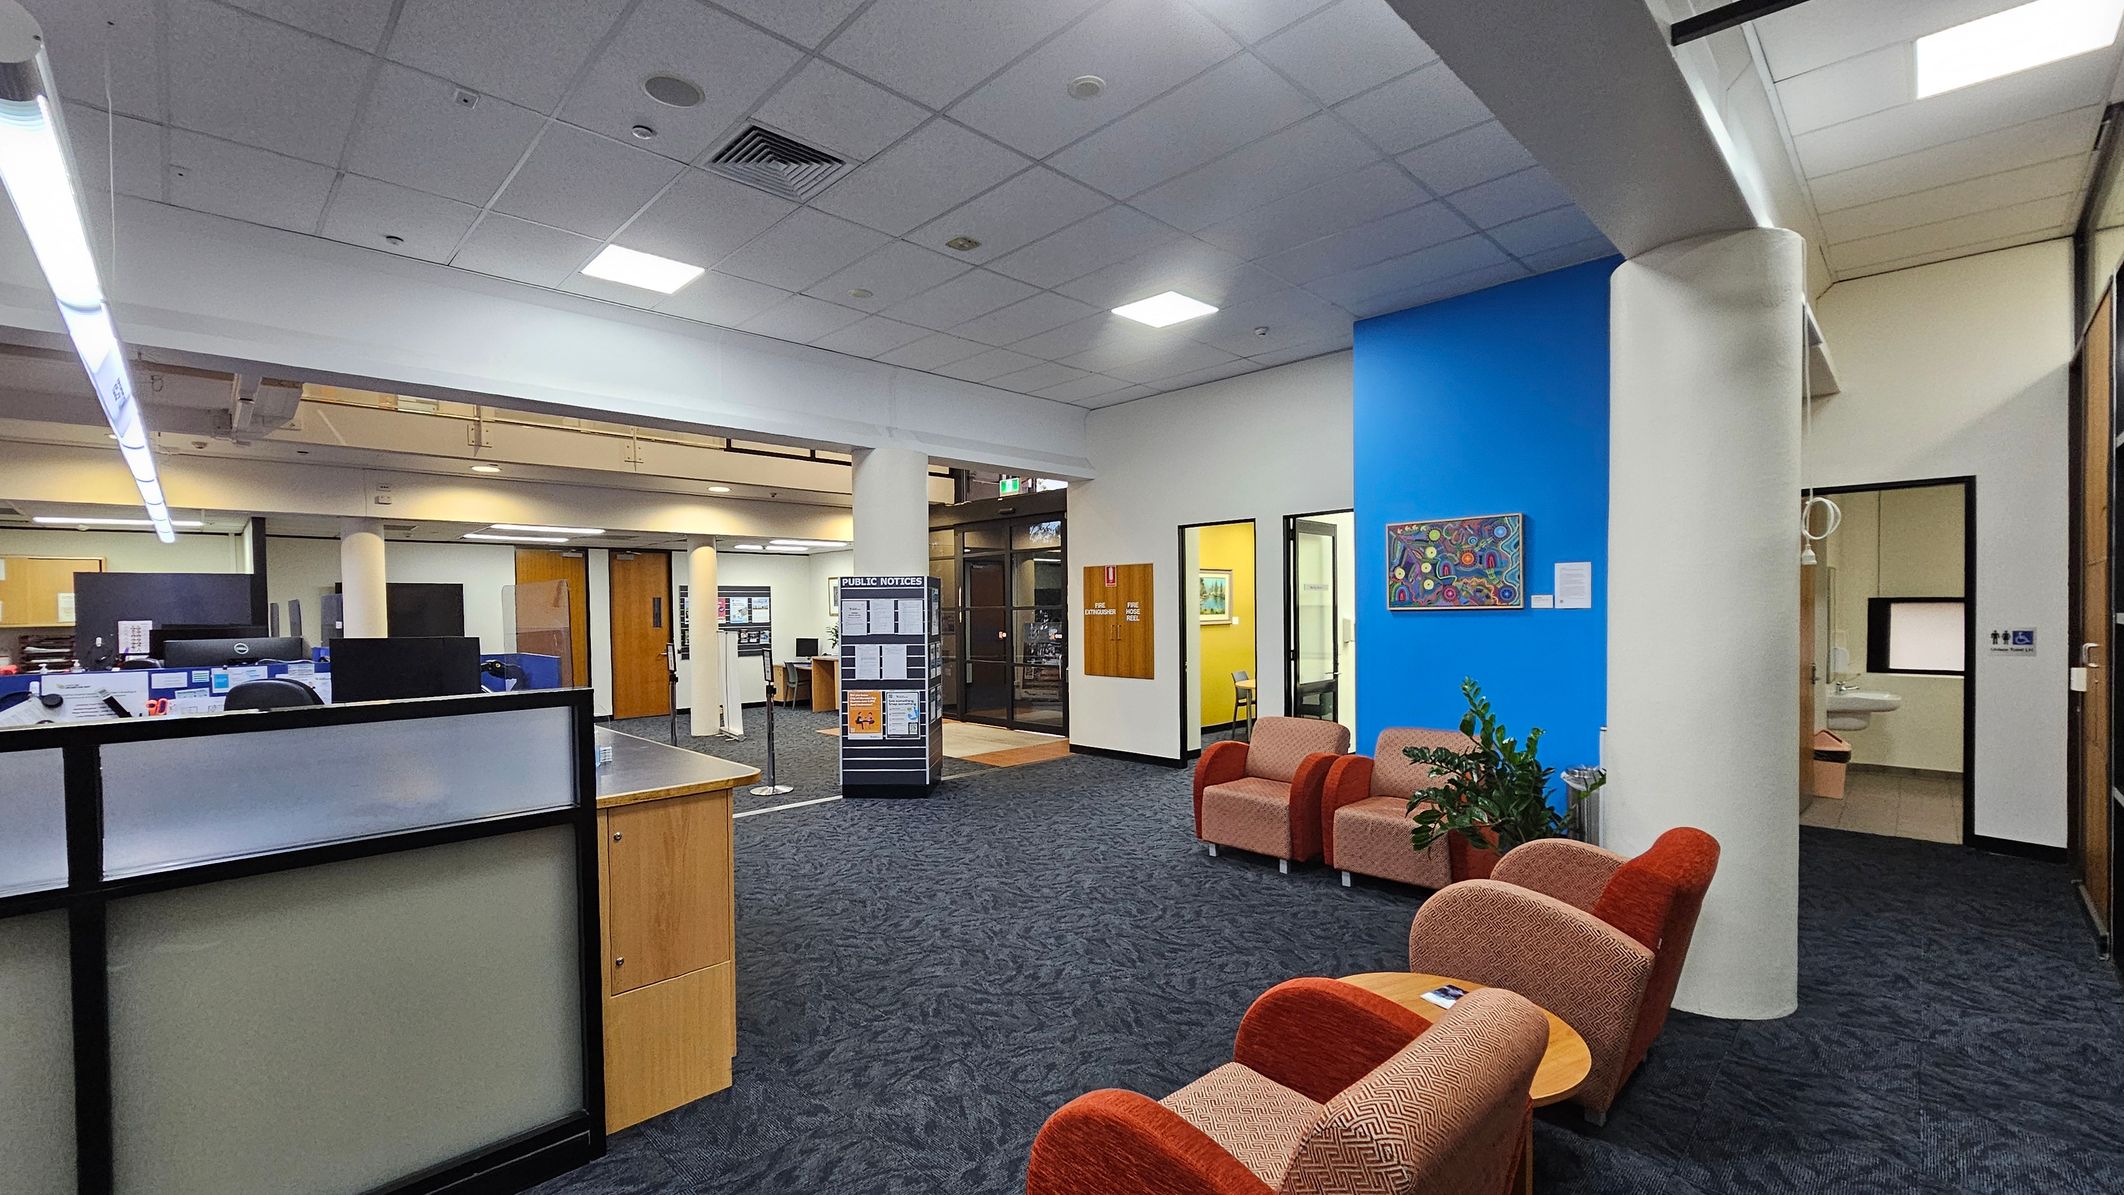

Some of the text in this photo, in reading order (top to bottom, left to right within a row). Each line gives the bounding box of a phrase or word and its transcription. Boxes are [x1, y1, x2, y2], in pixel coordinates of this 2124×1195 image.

[842, 577, 923, 586] PUBLIC NOTICES
[1127, 601, 1139, 609] FIRE
